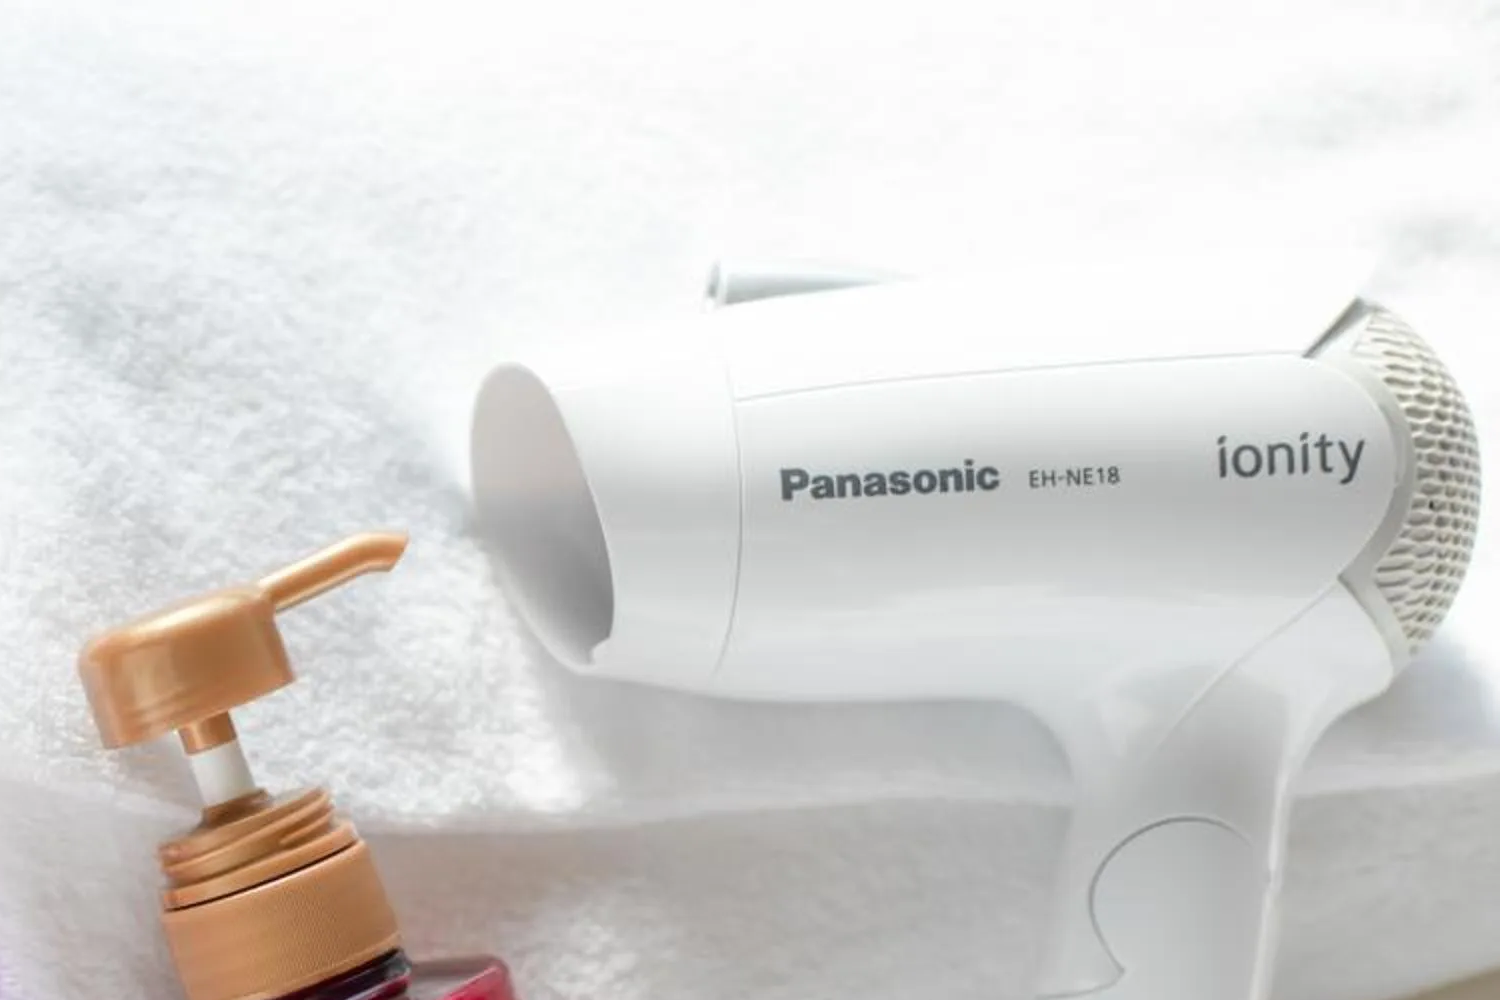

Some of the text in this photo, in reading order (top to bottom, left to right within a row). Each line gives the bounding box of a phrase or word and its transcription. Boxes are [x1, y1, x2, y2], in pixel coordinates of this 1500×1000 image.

[779, 460, 1122, 501] Panasonic EH-NE18
[1216, 432, 1367, 485] ionity
